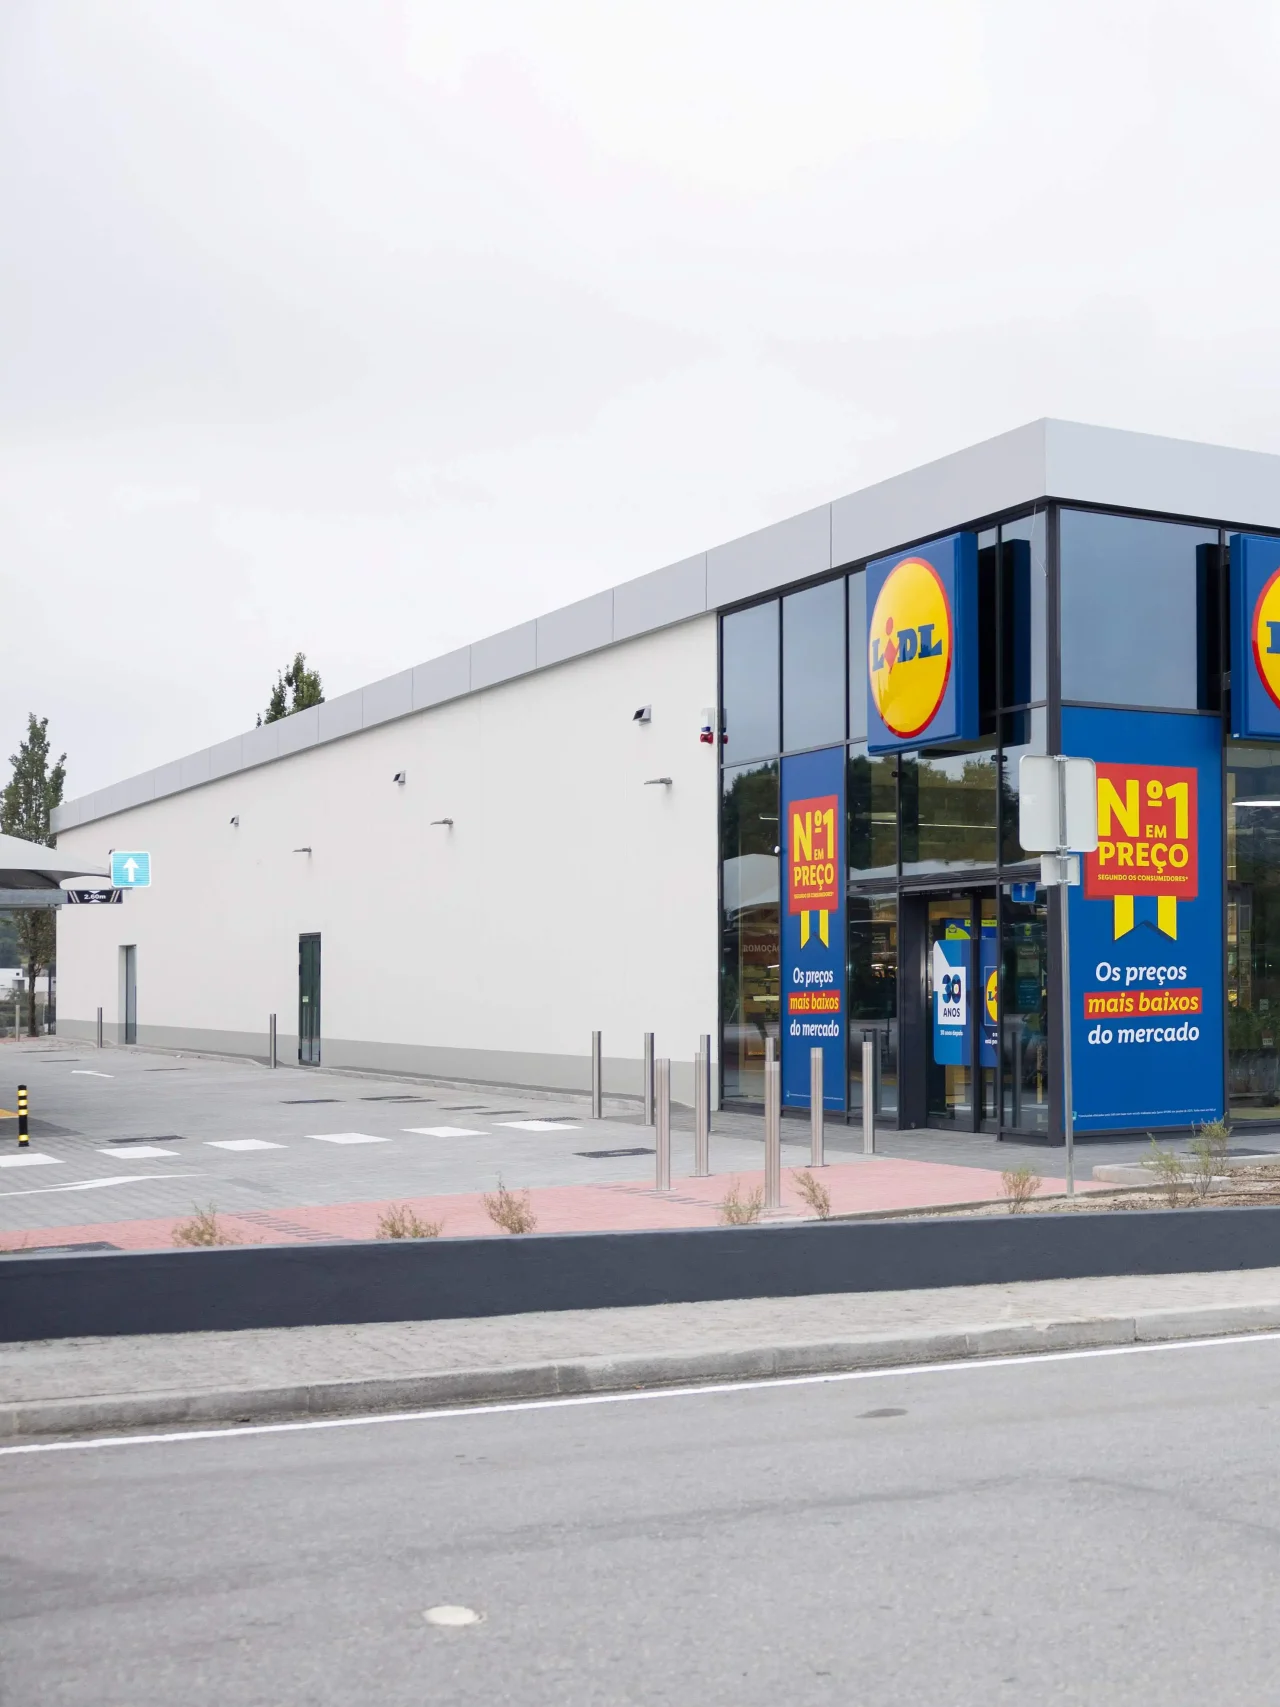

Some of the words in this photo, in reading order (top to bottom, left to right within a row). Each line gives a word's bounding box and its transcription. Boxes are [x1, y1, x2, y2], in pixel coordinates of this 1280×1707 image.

[1146, 824, 1167, 838] EM
[814, 848, 824, 860] EM
[1097, 841, 1189, 874] PREÇO
[793, 863, 835, 890] PREÇO
[793, 967, 804, 984] Os
[805, 970, 834, 987] preços
[1095, 962, 1121, 982] Os
[1125, 965, 1188, 986] preços
[790, 992, 810, 1010] mais
[811, 992, 839, 1010] baixos
[1088, 992, 1134, 1013] mais
[1138, 991, 1199, 1012] baixos
[943, 1007, 960, 1018] ANOS
[790, 1019, 801, 1036] do
[802, 1019, 840, 1037] mercado
[1087, 1024, 1113, 1044] do
[1117, 1021, 1200, 1043] mercado
